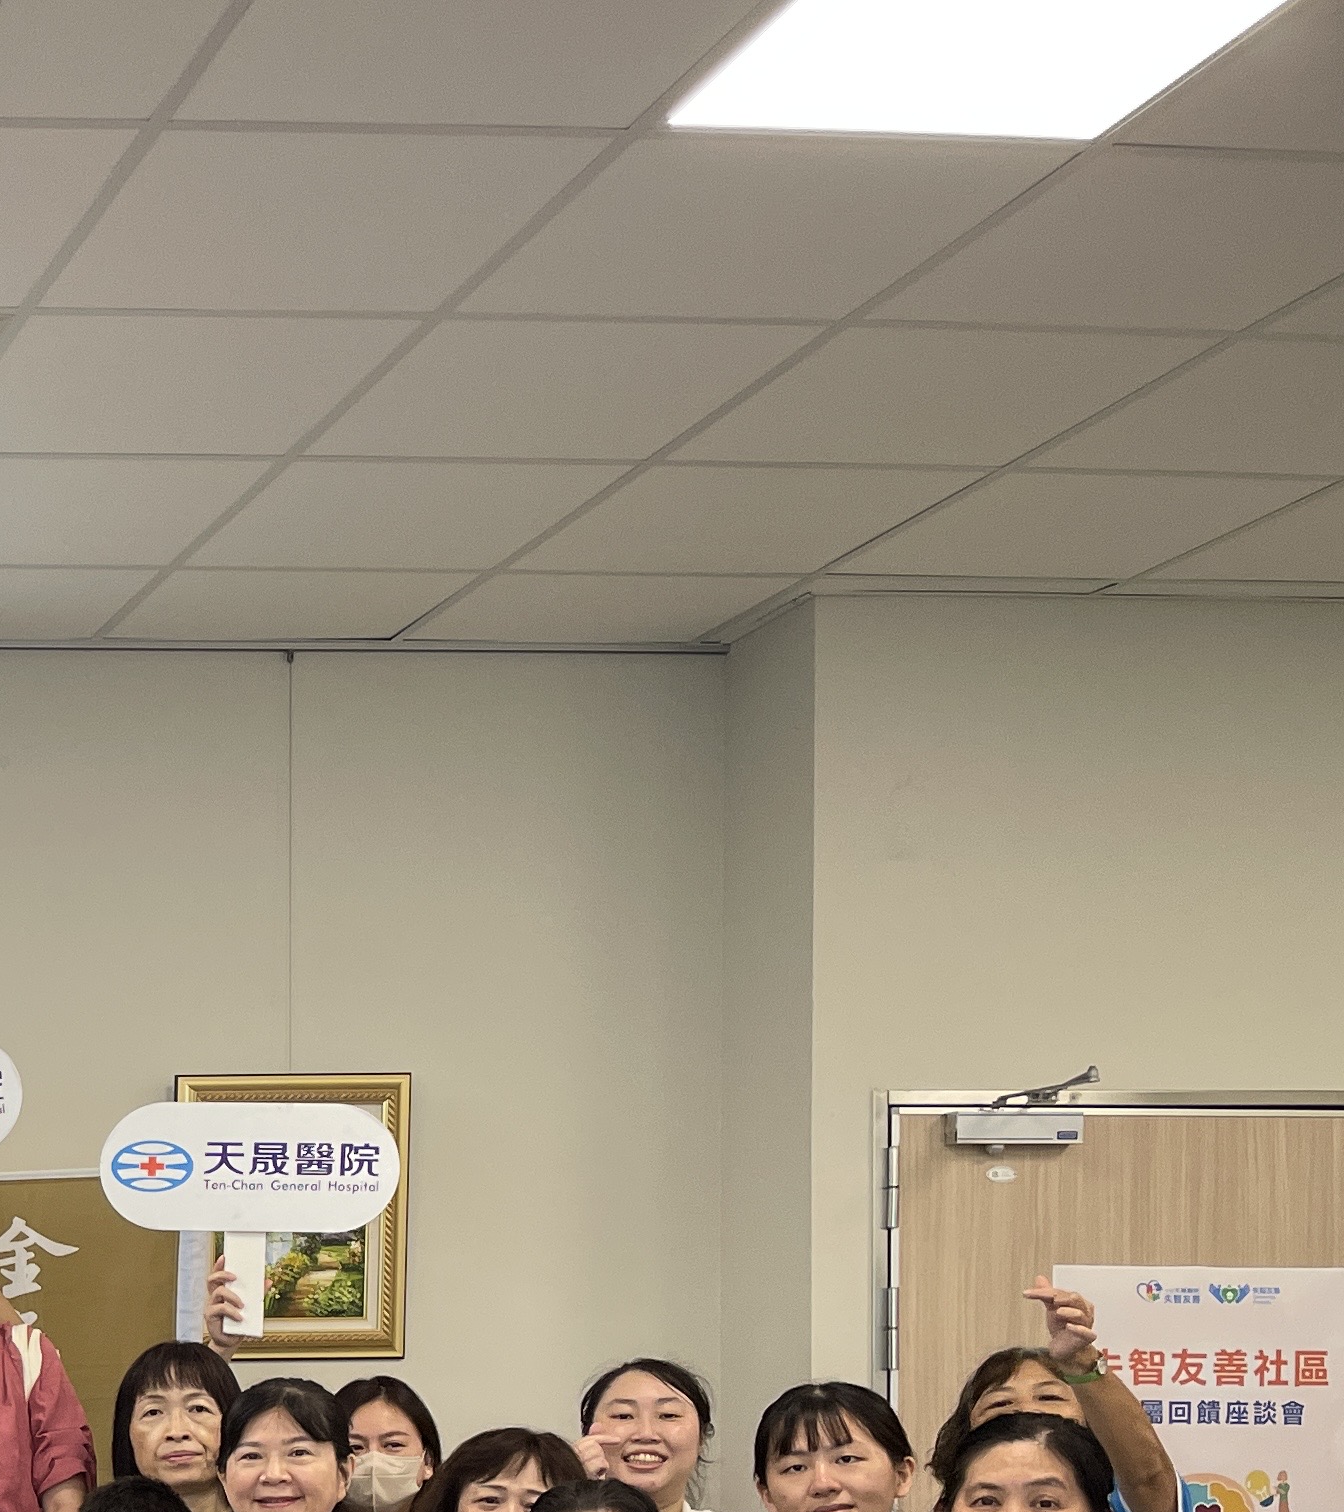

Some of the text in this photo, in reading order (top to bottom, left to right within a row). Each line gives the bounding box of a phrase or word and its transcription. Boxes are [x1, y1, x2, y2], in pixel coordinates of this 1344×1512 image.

[203, 1141, 381, 1178] 天晟醫院
[203, 1179, 380, 1194] Ten-Chan General Hospital
